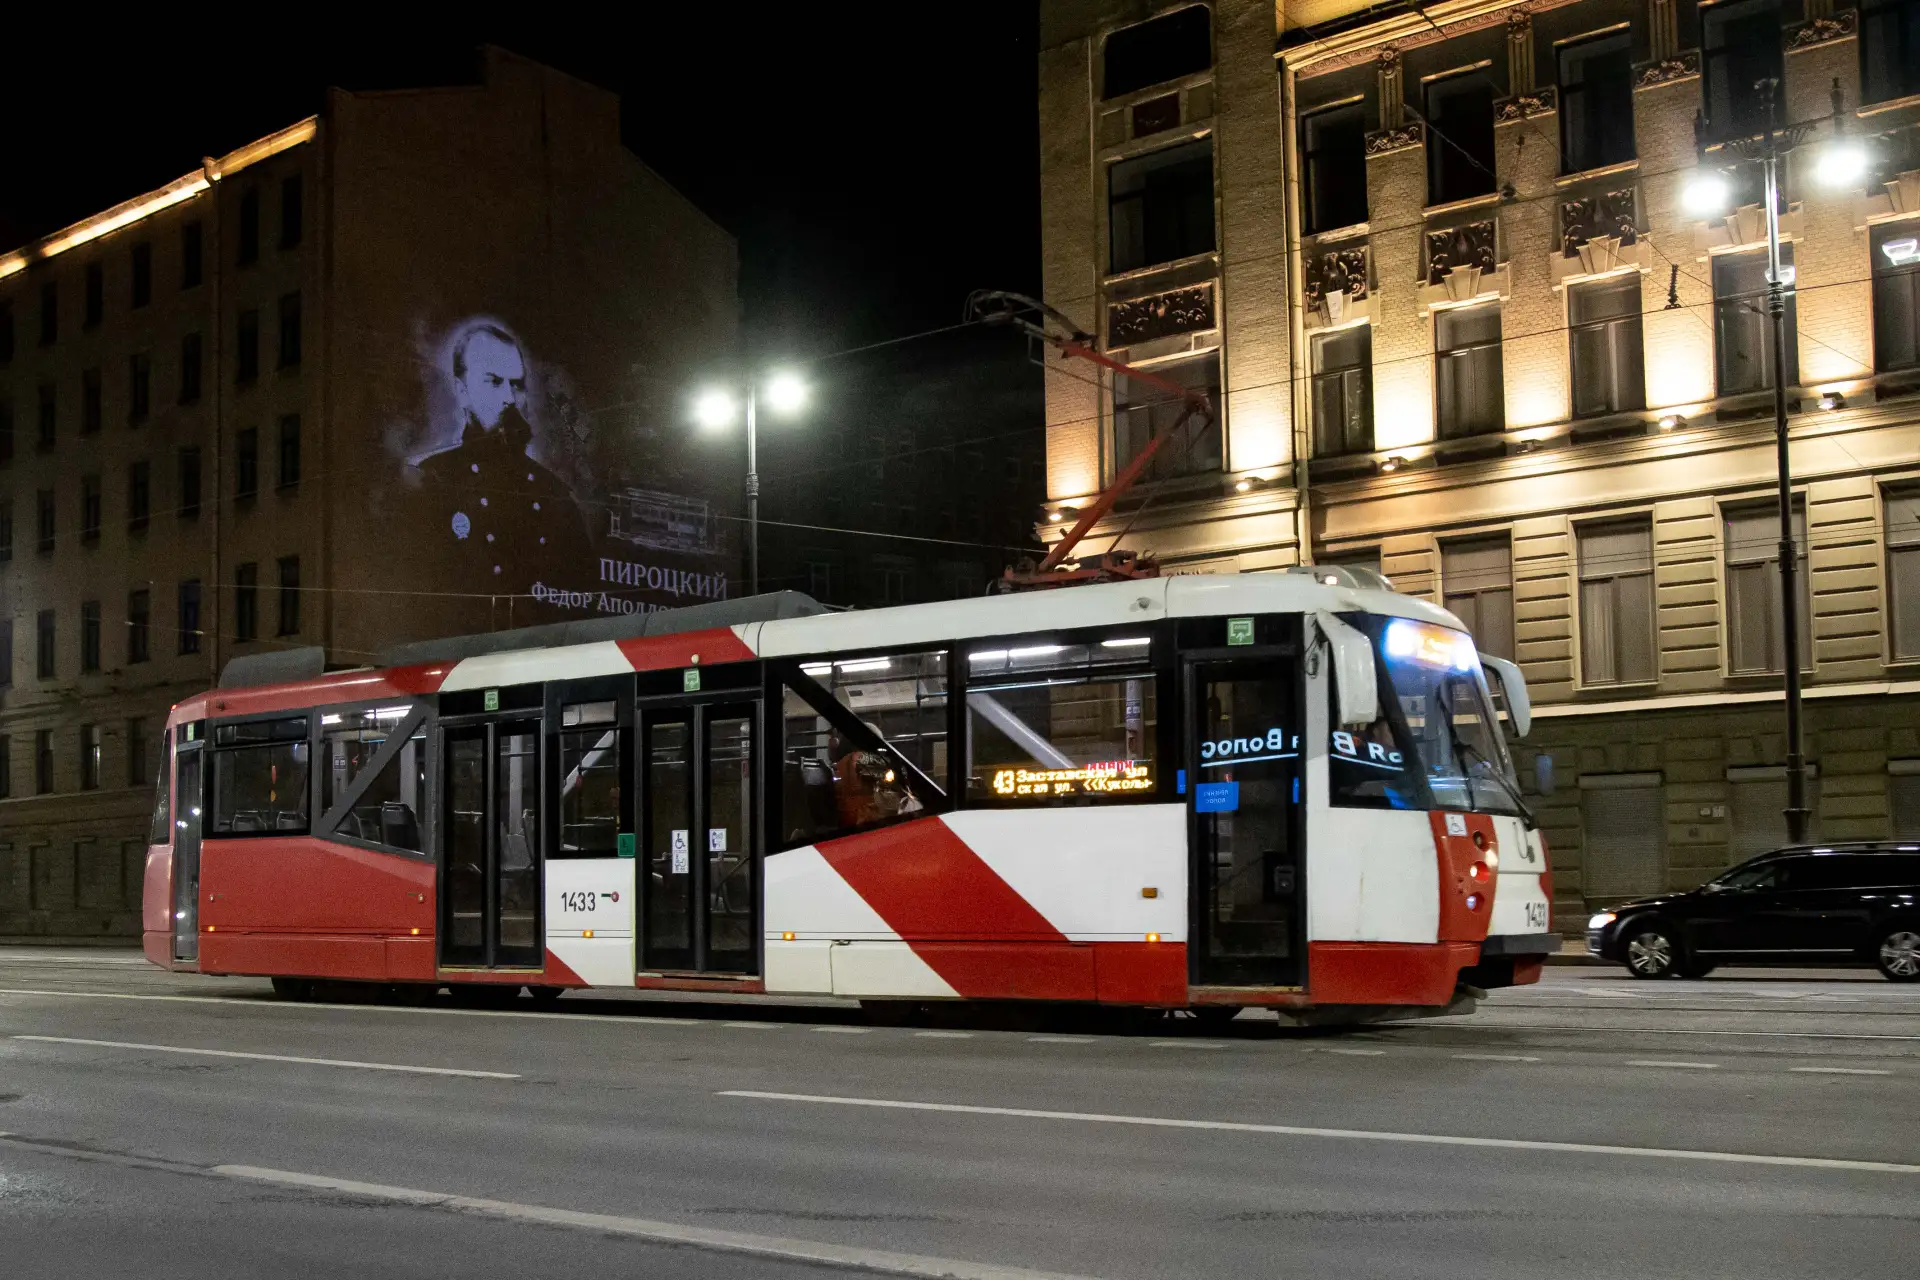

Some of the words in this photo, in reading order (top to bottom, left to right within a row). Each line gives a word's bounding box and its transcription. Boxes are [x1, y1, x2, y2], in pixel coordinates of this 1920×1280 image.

[600, 557, 728, 600] ПИРОЦКИЙ
[994, 770, 1015, 794] 43
[561, 891, 596, 912] 1433
